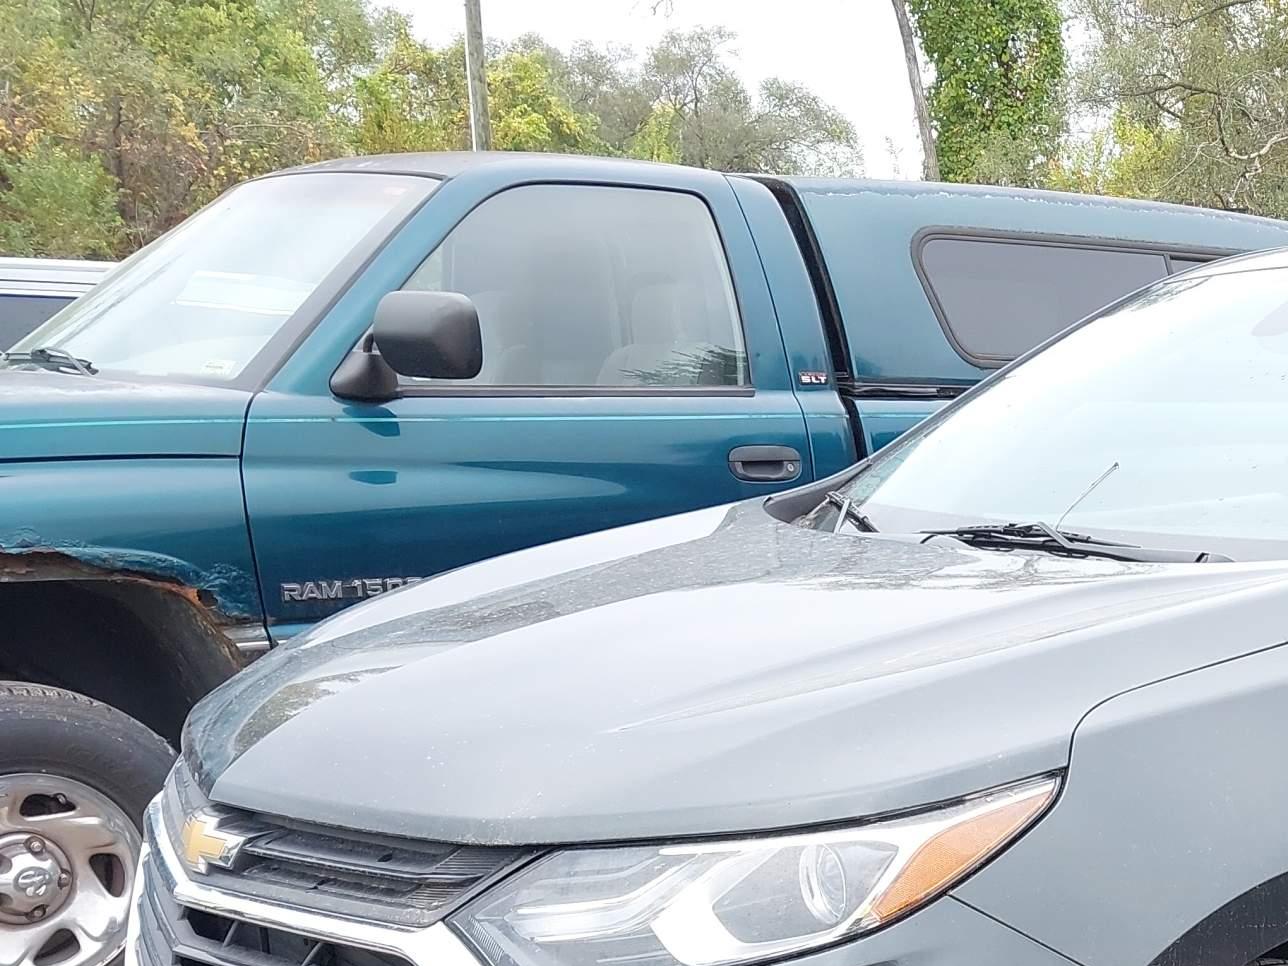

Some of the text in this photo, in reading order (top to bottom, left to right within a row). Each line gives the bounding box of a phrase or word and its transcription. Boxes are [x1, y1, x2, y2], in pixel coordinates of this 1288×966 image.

[801, 375, 828, 384] SLT
[281, 576, 424, 602] RAM 150
